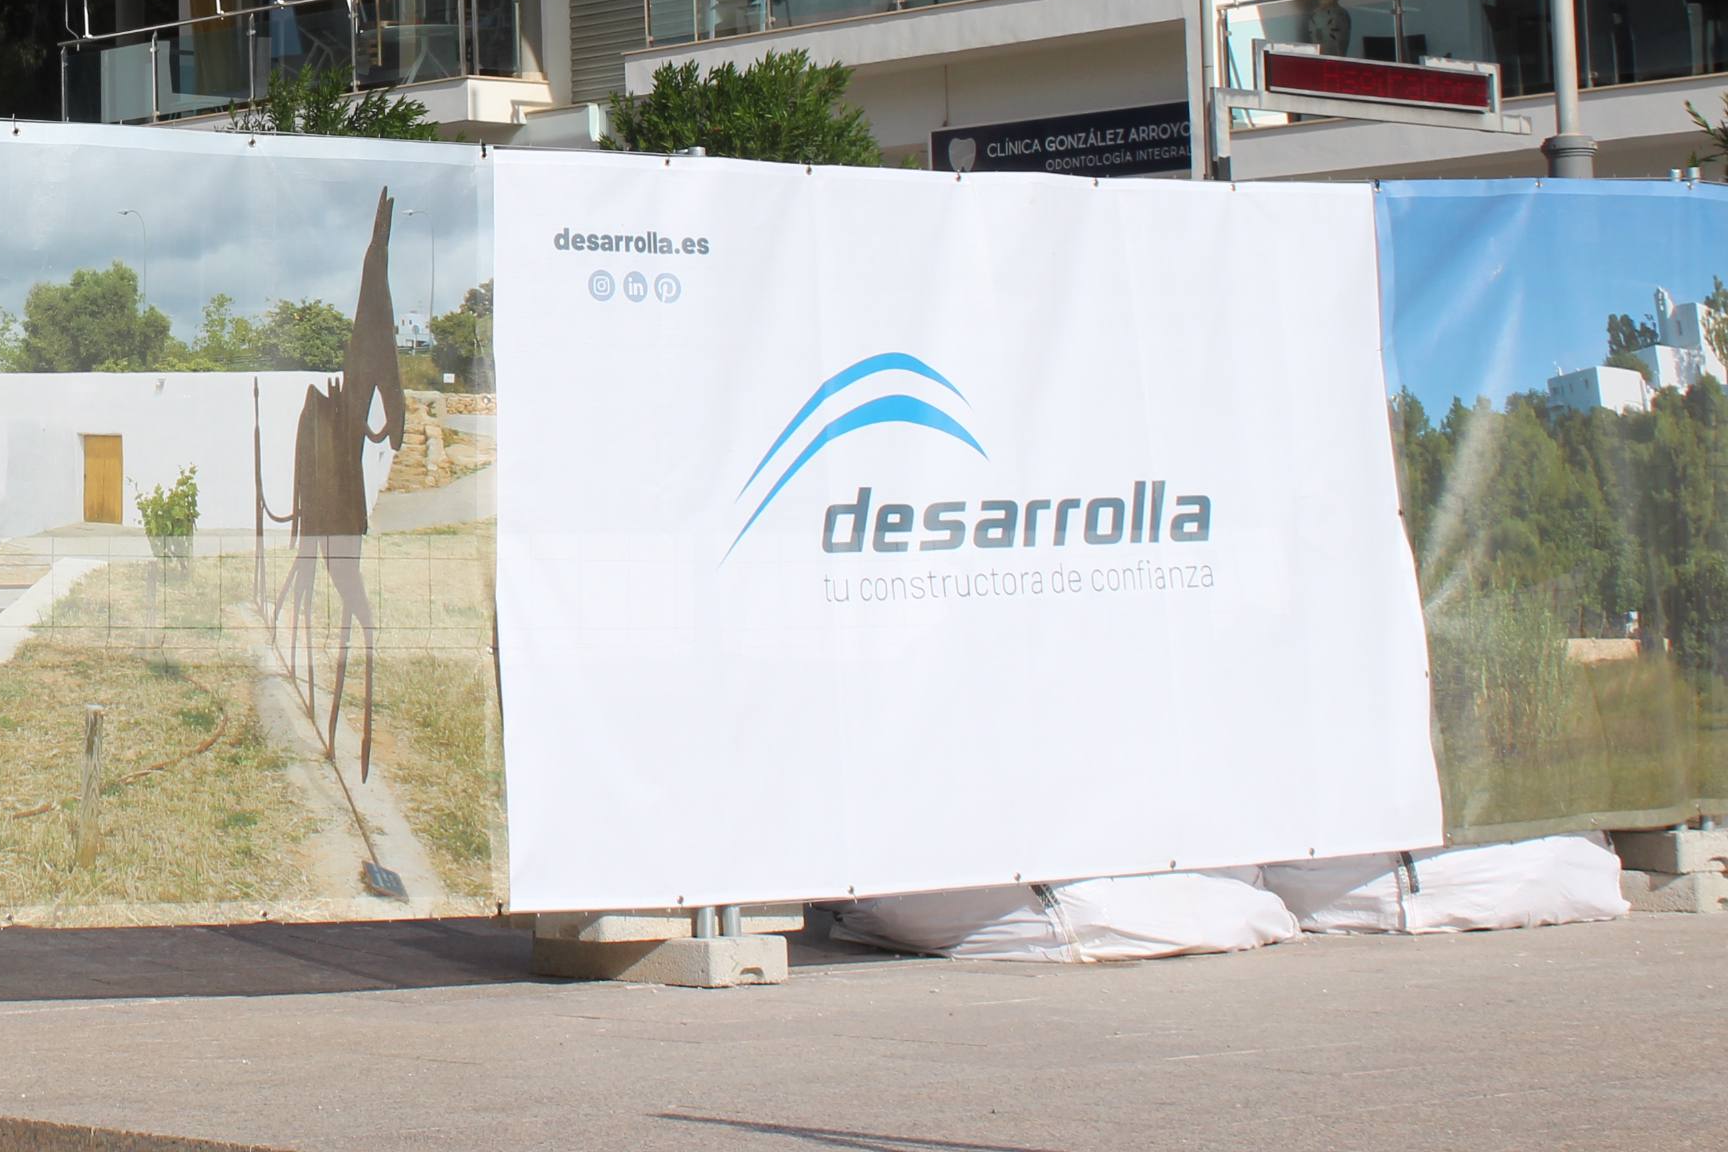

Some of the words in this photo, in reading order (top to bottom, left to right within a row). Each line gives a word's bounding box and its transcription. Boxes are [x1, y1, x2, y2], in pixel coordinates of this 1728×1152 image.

[986, 137, 1042, 158] CLÍNICA
[1044, 127, 1125, 152] GONZÁLEZ
[1045, 149, 1133, 171] ODONTOLOGÍA
[553, 227, 710, 255] desarrolla.es
[821, 480, 1212, 554] desarrolla
[823, 573, 850, 603] tu
[859, 566, 1044, 602] constructora
[1051, 562, 1083, 594] de
[1090, 559, 1215, 593] confianza
